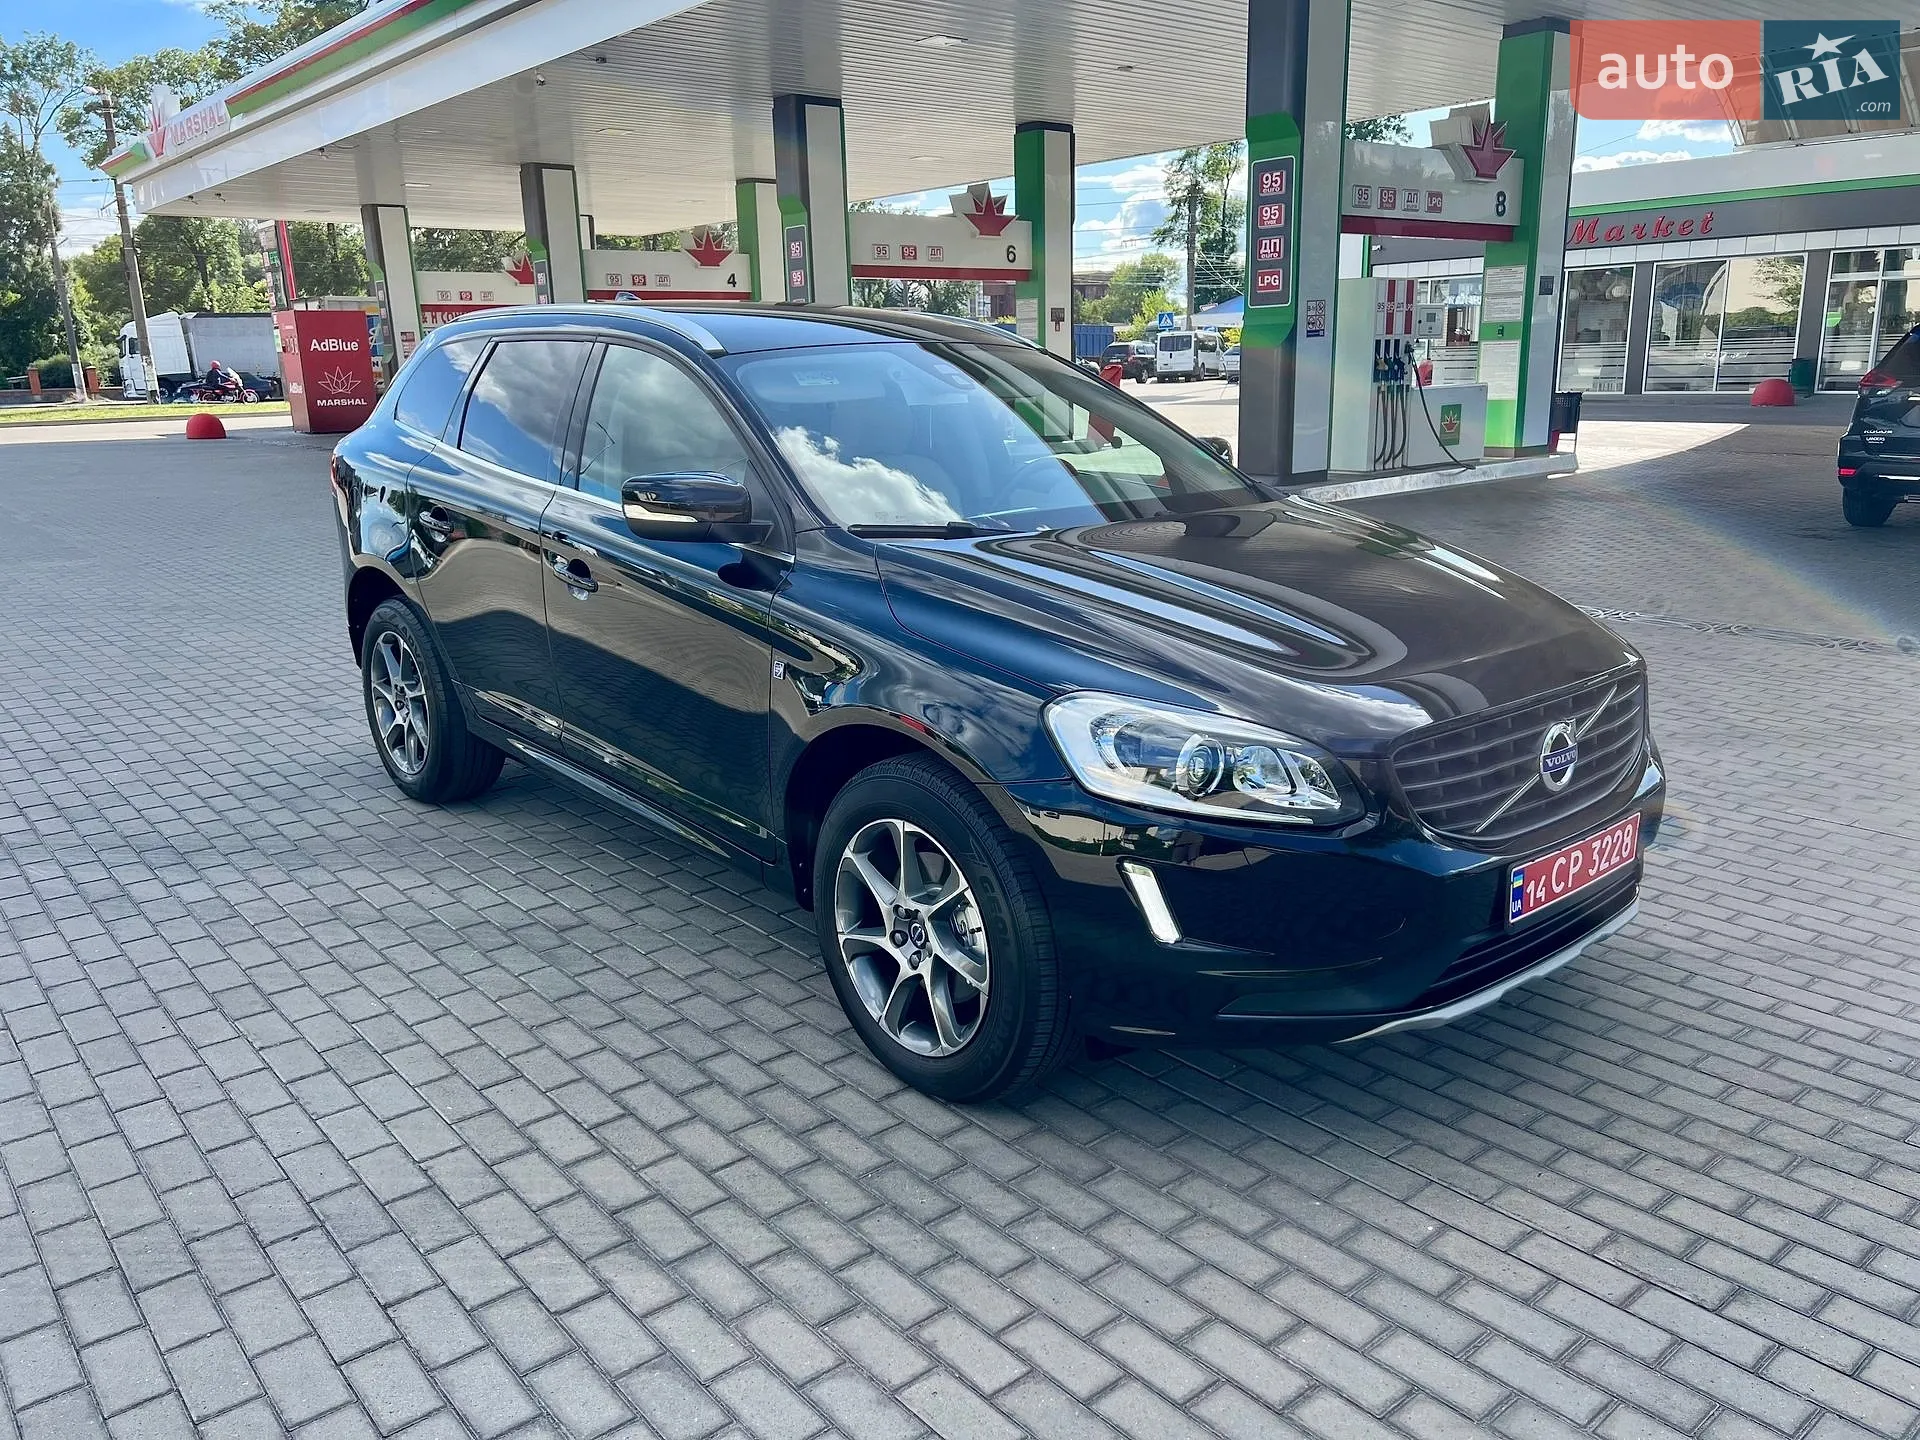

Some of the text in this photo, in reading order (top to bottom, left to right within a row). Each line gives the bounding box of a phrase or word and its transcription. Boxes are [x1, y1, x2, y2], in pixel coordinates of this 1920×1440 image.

[1263, 171, 1281, 189] 95
[1357, 188, 1369, 201] 95
[1382, 190, 1394, 203] 95
[1406, 192, 1418, 203] ДП
[1428, 197, 1442, 207] LPG
[1495, 190, 1507, 217] 8
[1262, 205, 1280, 220] 95
[1567, 211, 1714, 244] Market
[790, 242, 800, 253] 95
[876, 246, 887, 255] 95
[904, 246, 915, 256] 95
[930, 247, 942, 257] ДП
[1260, 238, 1280, 254] ДП
[1006, 244, 1016, 263] 6
[609, 275, 620, 283] 95
[633, 275, 645, 283] 95
[727, 273, 737, 288] 4
[792, 272, 801, 282] 95
[1258, 274, 1280, 287] LPG
[1376, 302, 1385, 310] 95
[310, 339, 359, 352] AdBlue
[316, 398, 368, 407] MARSHAL
[1546, 749, 1576, 767] VOLVO
[1526, 823, 1633, 908] 14 CP 3228
[1511, 899, 1522, 913] UA
